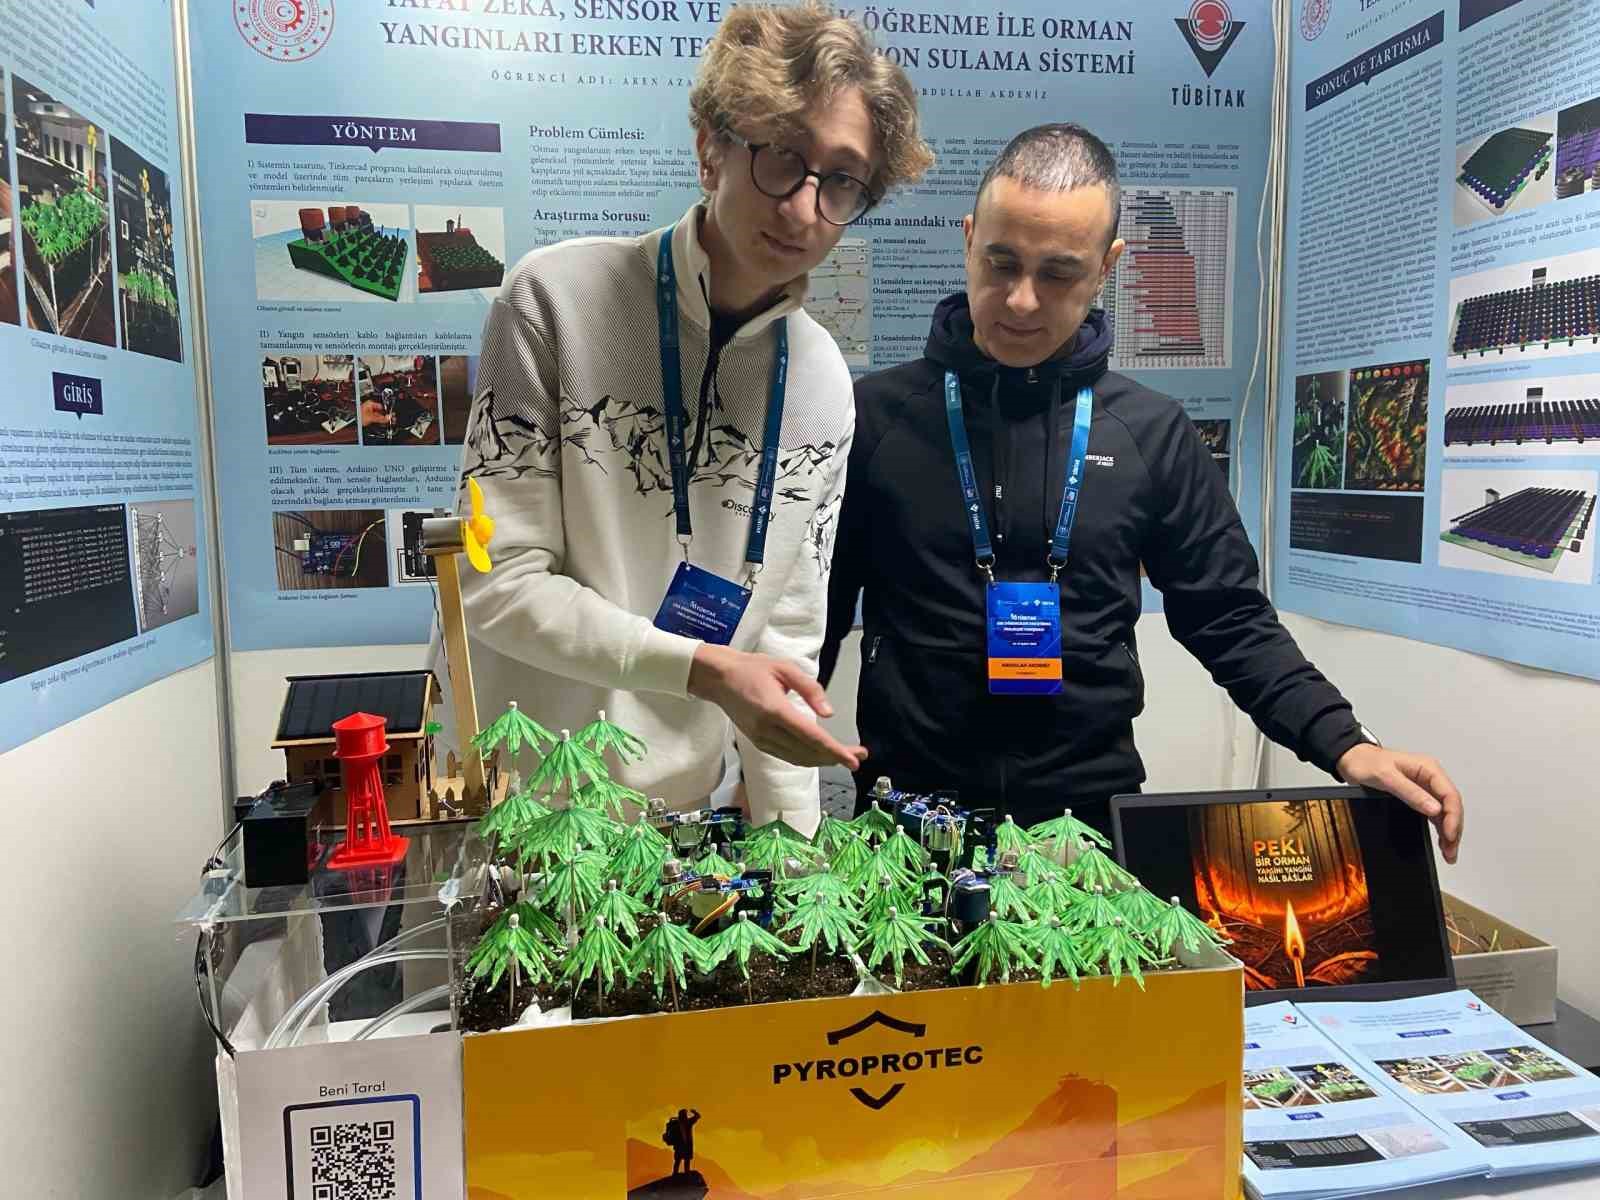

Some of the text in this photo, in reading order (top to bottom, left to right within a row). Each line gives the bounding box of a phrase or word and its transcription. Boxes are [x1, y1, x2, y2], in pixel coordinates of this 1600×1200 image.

[687, 1, 722, 23] VE
[864, 6, 991, 37] ÖĞRENME
[997, 12, 1035, 37] İLE
[1043, 17, 1135, 42] ORMAN
[381, 21, 562, 54] YANGINLARI
[571, 34, 662, 57] ERKEN
[928, 47, 1031, 73] SULAMA
[1039, 47, 1136, 75] SİSTEMİ
[1313, 28, 1432, 100] SONUÇ VE TARTIŞMA
[1172, 83, 1247, 109] TÜBİTAK
[331, 121, 417, 142] YÖNTEM
[529, 124, 646, 141] Problem Cümlesi:
[534, 208, 651, 225] Araştırma Sorusu:
[848, 217, 892, 228] alışma
[894, 214, 946, 229] anındaki
[278, 330, 305, 341] Yangın
[357, 330, 379, 340] kablo
[313, 342, 323, 350] ve
[63, 380, 93, 410] GİRİŞ
[290, 465, 308, 474] Tüm
[345, 465, 378, 474] Arduino
[384, 464, 406, 473] UNO
[325, 475, 343, 484] Tüm
[270, 486, 296, 496] olacak
[727, 498, 777, 522] Discoy
[1255, 856, 1311, 867] BİR ORMAN
[773, 1046, 984, 1085] PYROPROTEC
[319, 1080, 386, 1098] Beni Tara!
